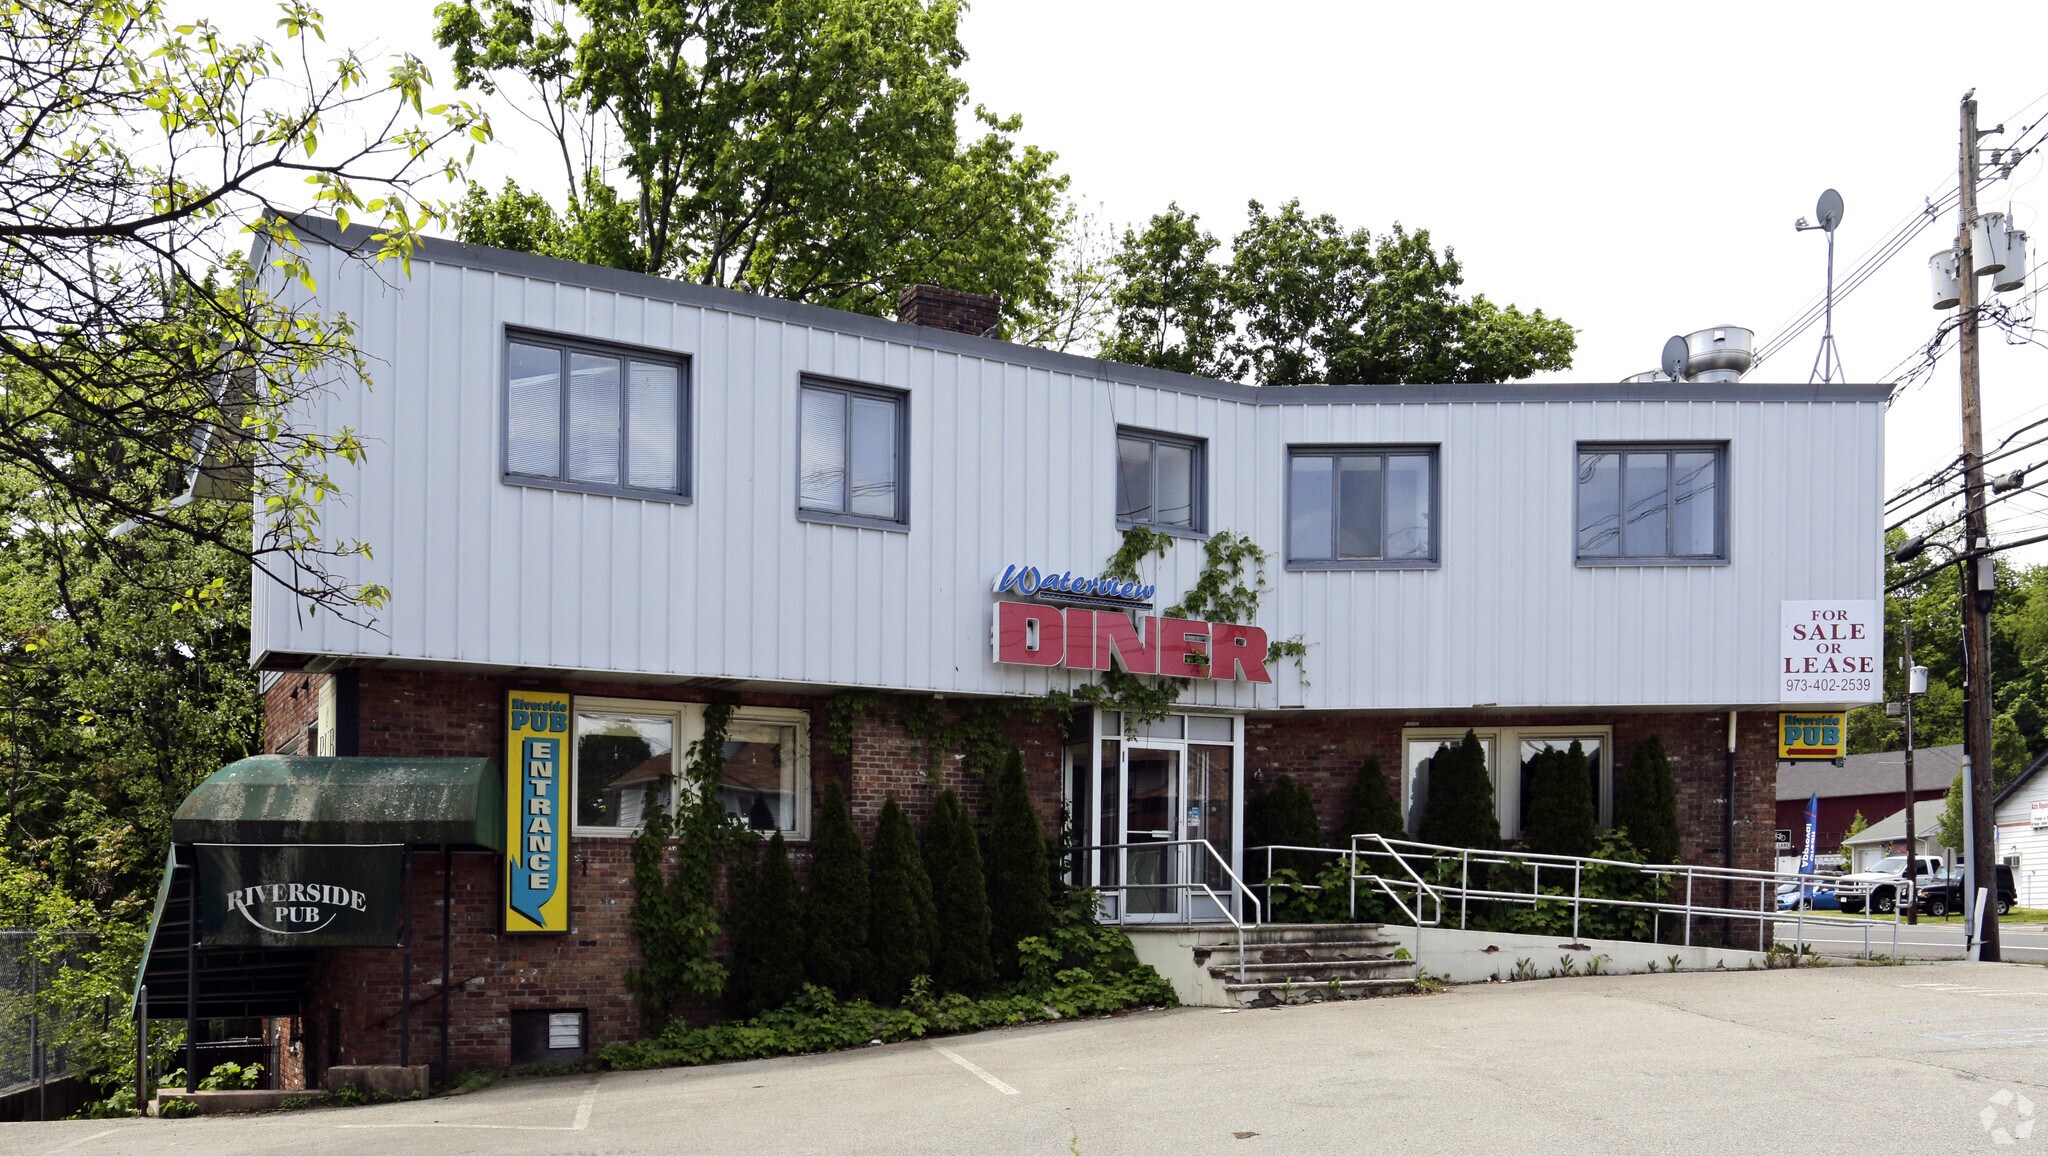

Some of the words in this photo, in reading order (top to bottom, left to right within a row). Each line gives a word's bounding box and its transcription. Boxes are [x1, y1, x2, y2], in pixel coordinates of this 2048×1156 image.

[998, 563, 1156, 601] Waterview
[1811, 610, 1848, 621] FOR
[1793, 623, 1865, 640] SALE
[994, 601, 1272, 683] DINER
[1816, 643, 1842, 654] OR
[1784, 657, 1874, 673] LEASE
[1786, 679, 1870, 691] 973-402-2539
[512, 698, 567, 712] Riverside
[511, 710, 568, 733] PUB
[1785, 715, 1839, 725] Riverside
[1785, 726, 1840, 746] PUB
[529, 742, 552, 889] ENTRANCE
[227, 883, 367, 912] RIVERSIDE
[275, 906, 320, 923] PUB
